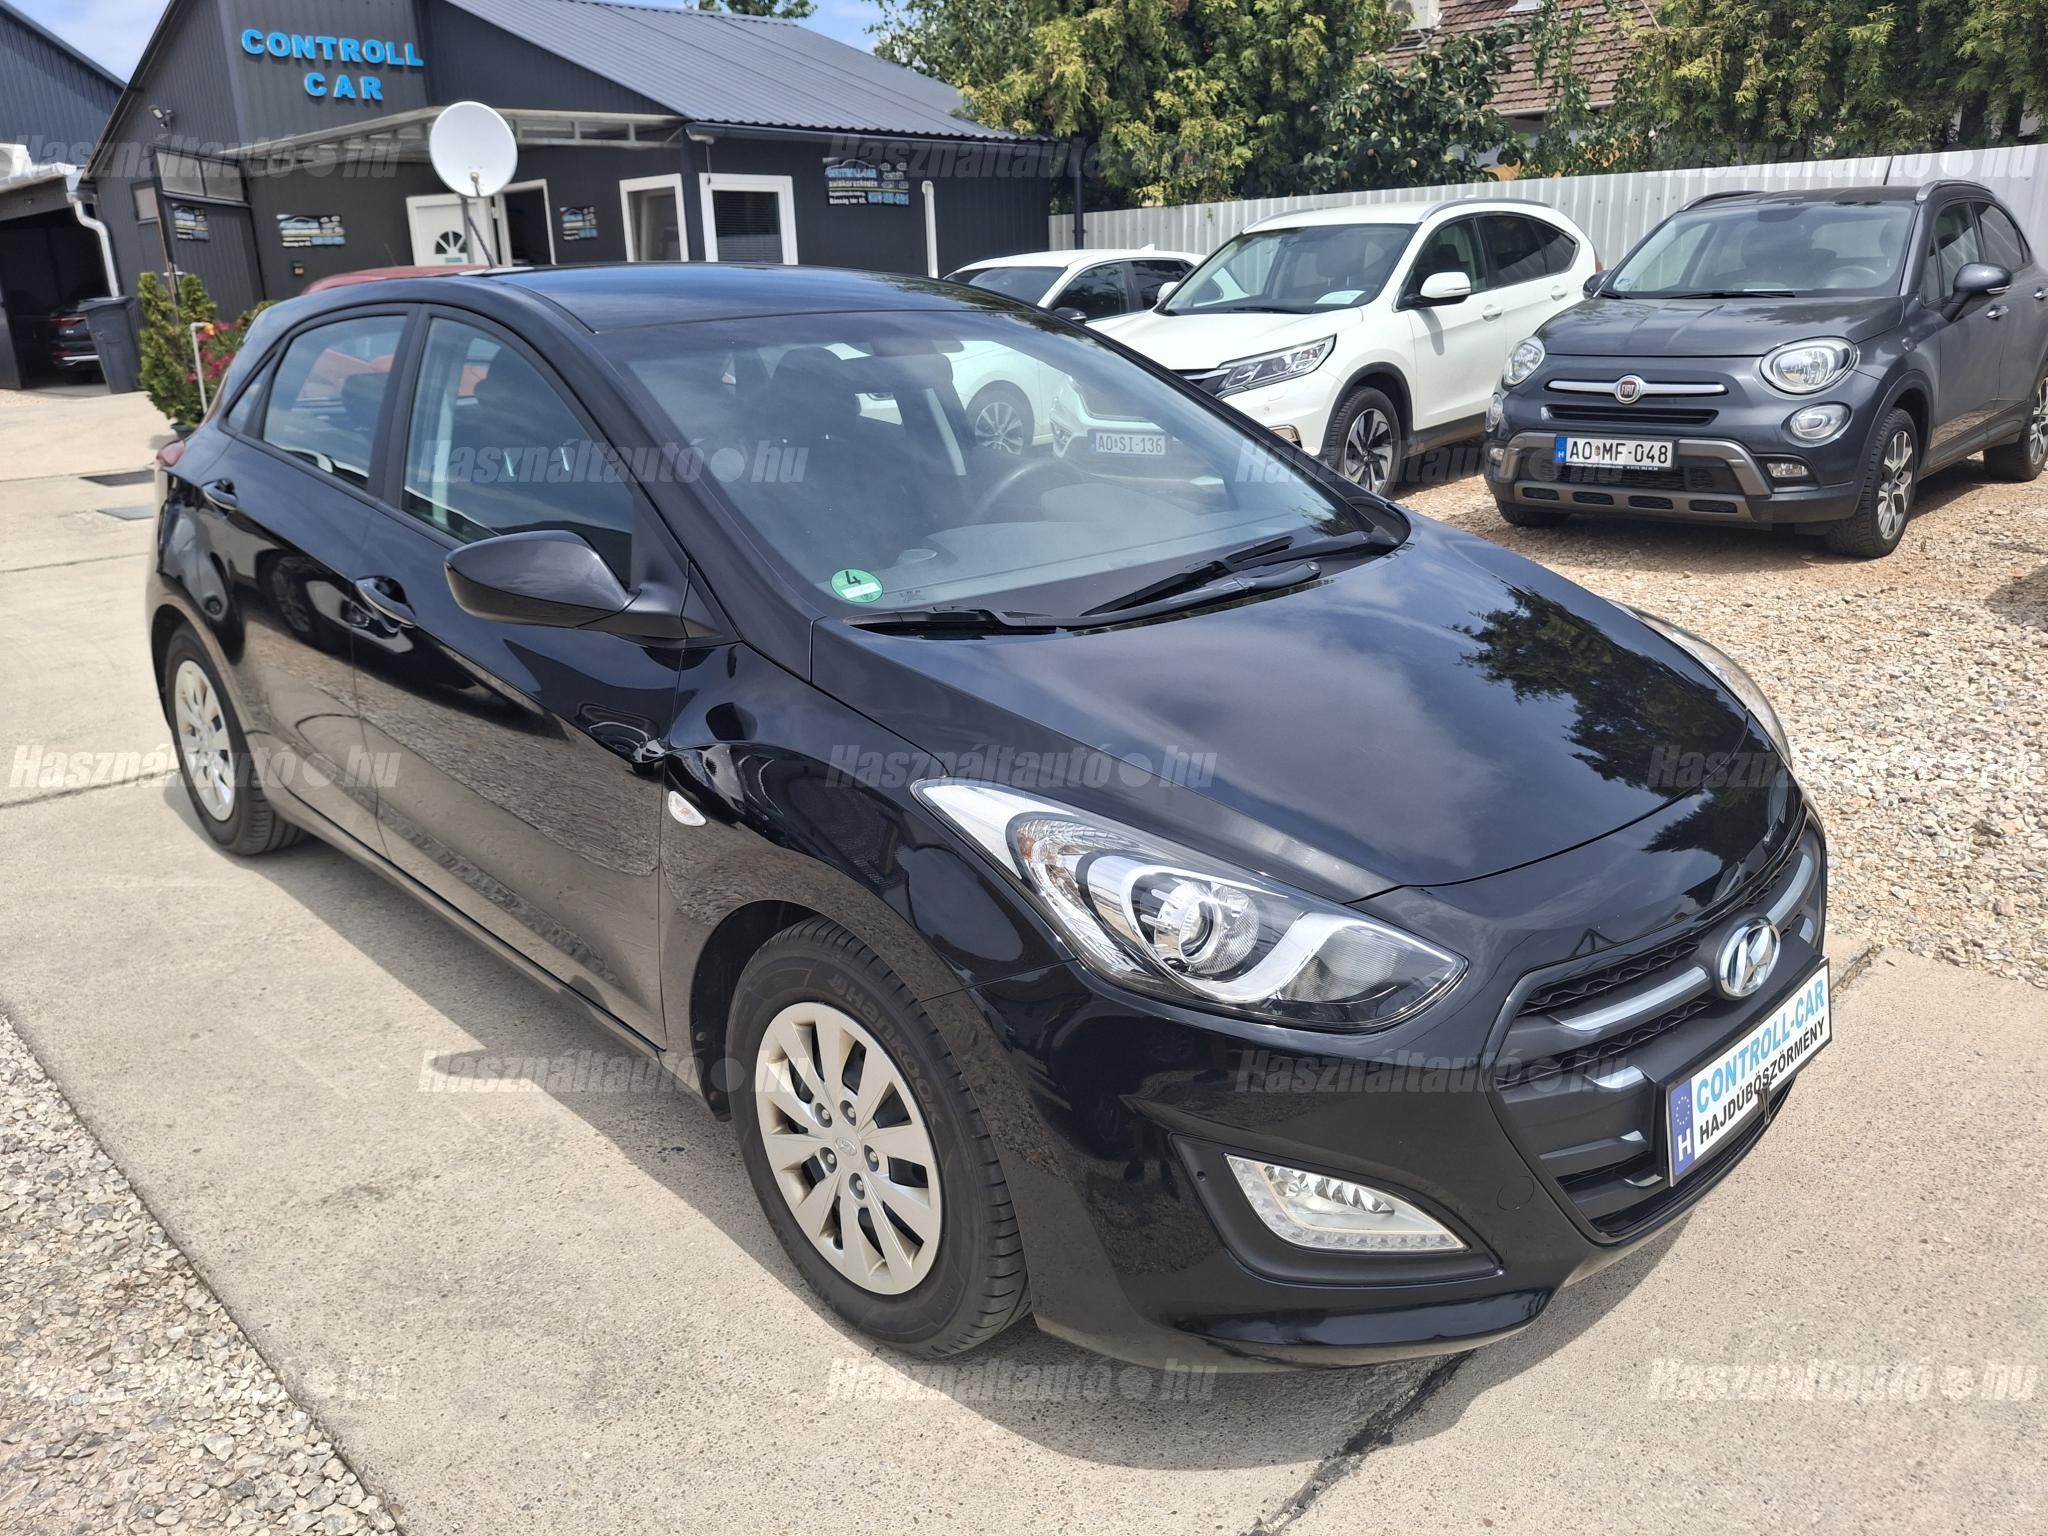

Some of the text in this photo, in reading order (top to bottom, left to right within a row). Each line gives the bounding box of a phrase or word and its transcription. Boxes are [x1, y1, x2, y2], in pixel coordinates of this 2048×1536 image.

[241, 29, 424, 67] CONTROLL
[304, 72, 384, 100] CAR
[1621, 384, 1635, 396] FIAT
[1558, 450, 1565, 458] H
[845, 570, 861, 585] 4
[1696, 979, 1825, 1114] CONTROLL-CAR
[1699, 1016, 1825, 1145] HAJDÚBÖSZÖRMÉNY
[1678, 1128, 1691, 1161] H
